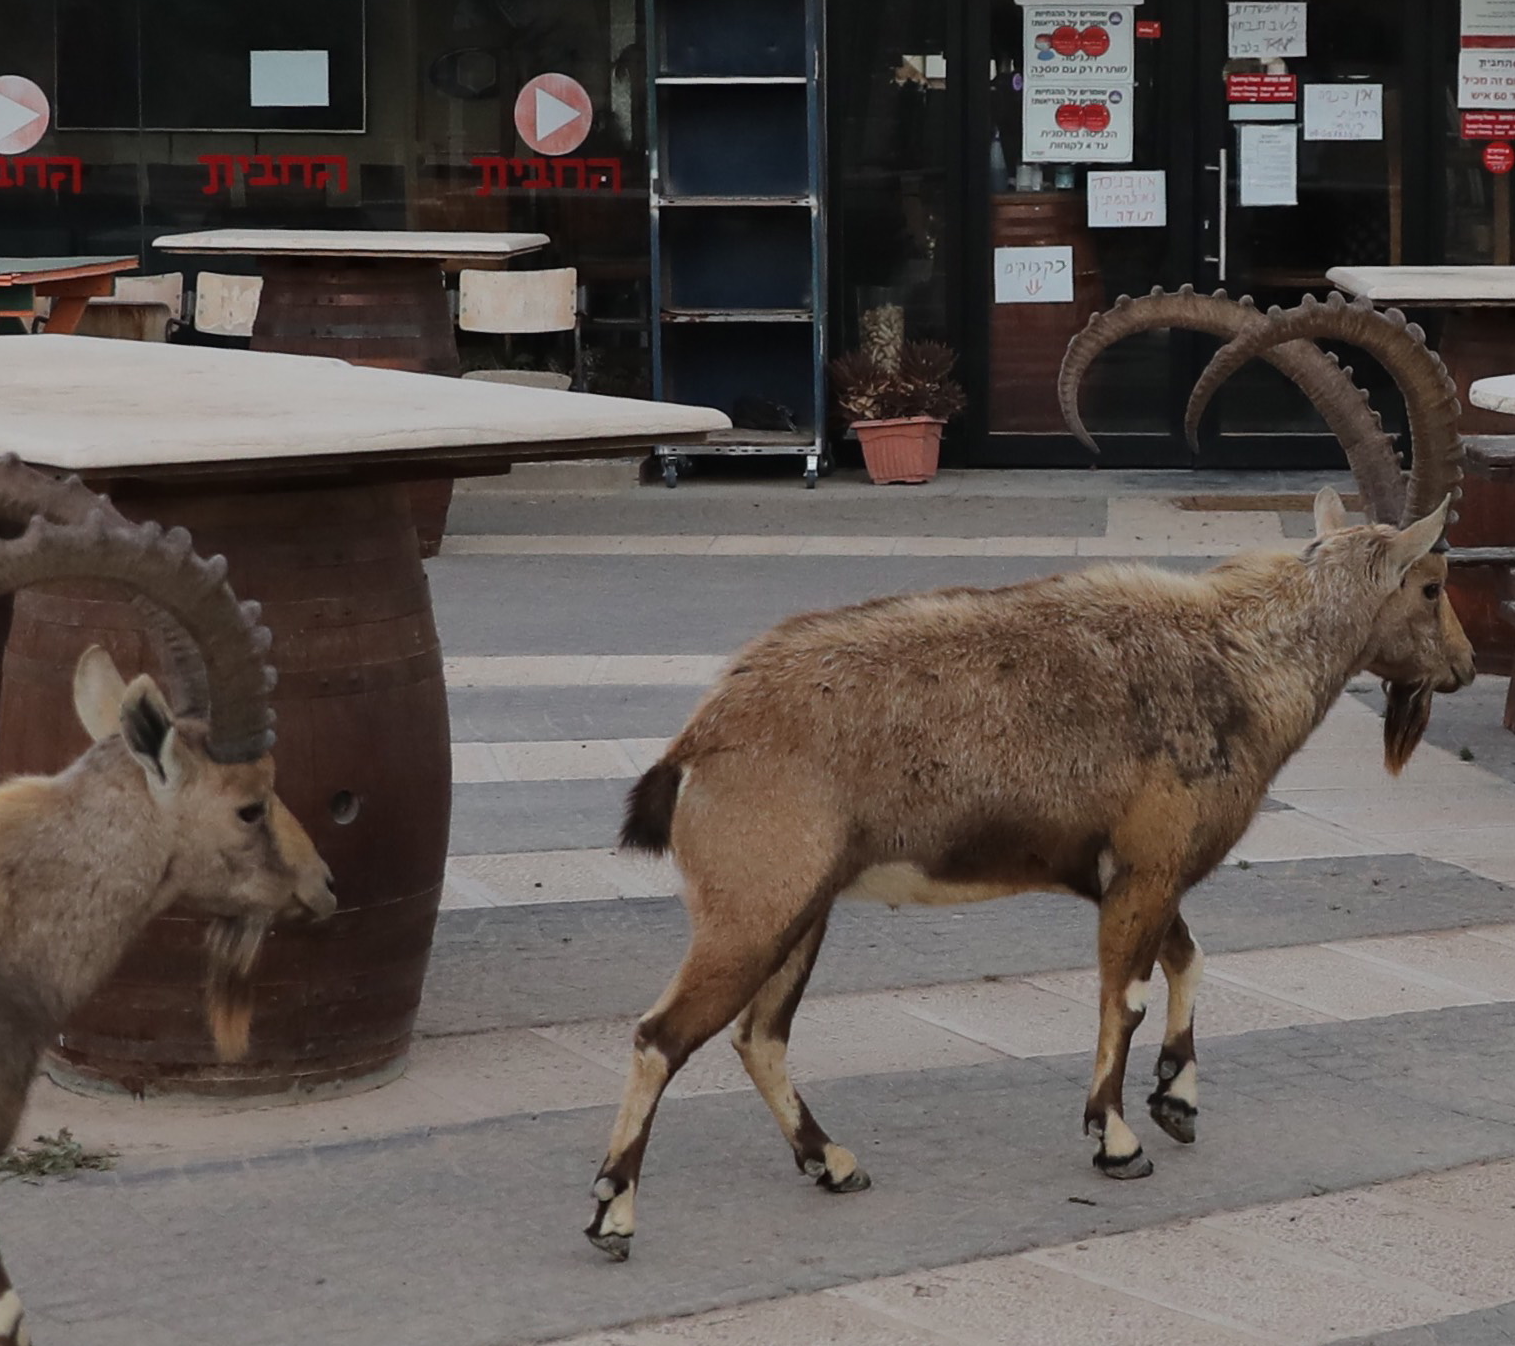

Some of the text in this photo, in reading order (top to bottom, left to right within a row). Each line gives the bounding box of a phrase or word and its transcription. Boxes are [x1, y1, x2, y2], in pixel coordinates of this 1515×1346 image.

[1030, 65, 1128, 75] מותרת רק עם מסכה
[1462, 75, 1488, 86] מכיל
[1490, 76, 1504, 86] זה
[1471, 92, 1491, 101] איש
[1494, 92, 1507, 101] 60
[1094, 141, 1108, 150] עד
[197, 153, 349, 195] החבית
[470, 155, 623, 196] החבית
